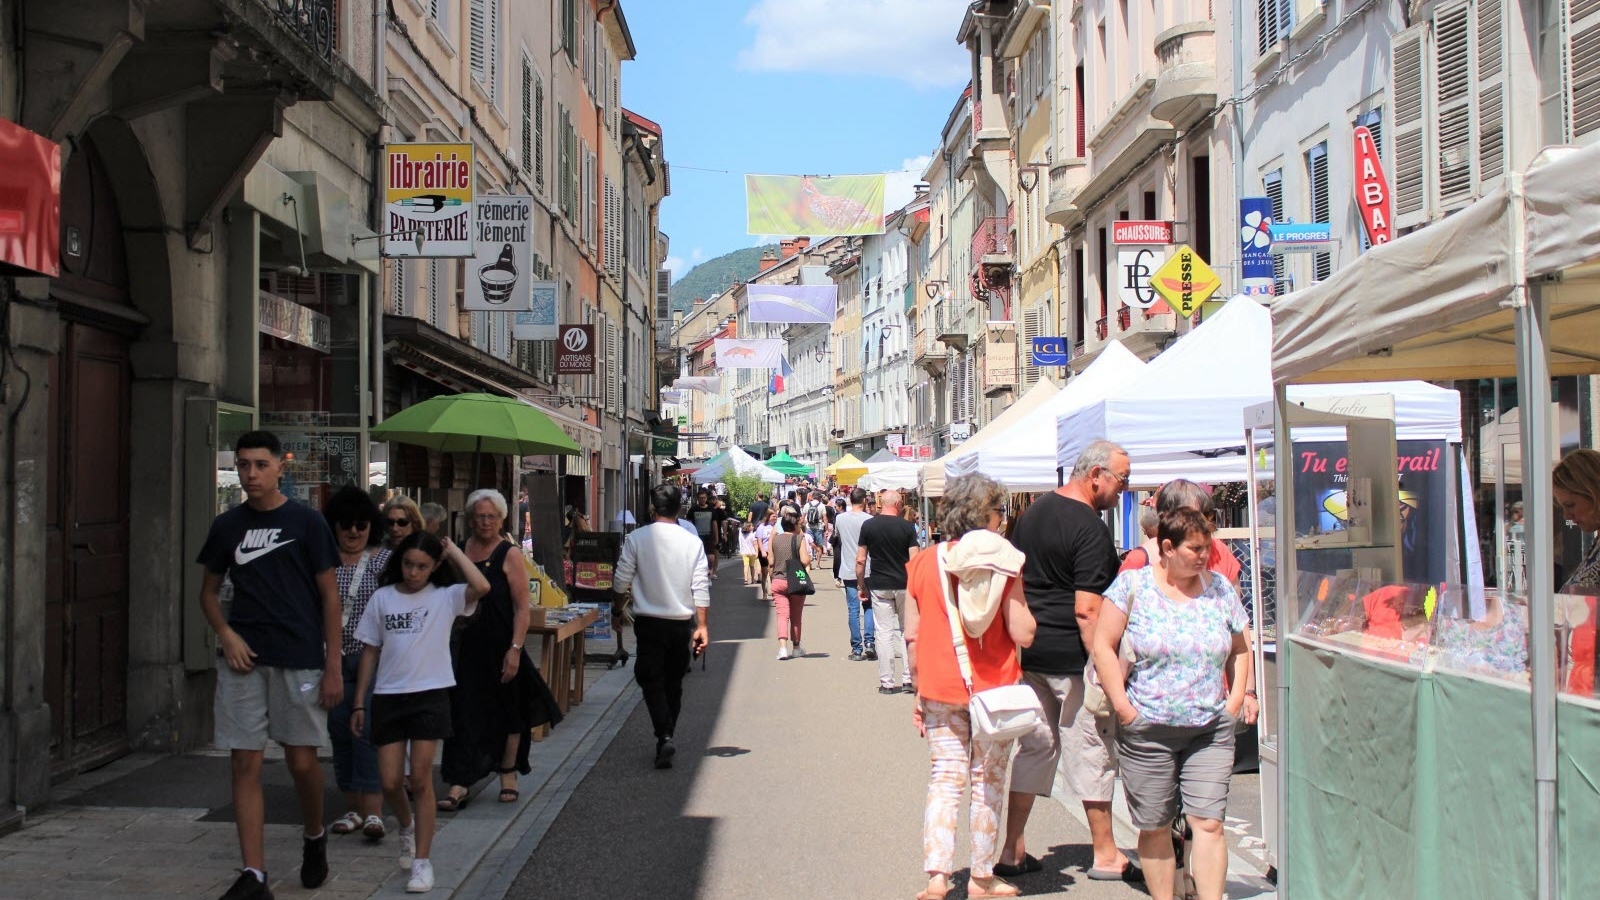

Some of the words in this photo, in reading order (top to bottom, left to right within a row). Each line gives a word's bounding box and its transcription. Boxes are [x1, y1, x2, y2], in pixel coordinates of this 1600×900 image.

[389, 153, 469, 189] librairie
[476, 200, 529, 221] rémerie
[1116, 225, 1171, 240] CHAUSSURES
[1273, 233, 1285, 241] LE
[1181, 253, 1192, 311] PRESSE
[1035, 343, 1065, 354] LCL
[560, 354, 592, 362] ARTISANS
[1301, 451, 1327, 473] Tu
[1335, 457, 1349, 472] e
[1397, 447, 1441, 472] rail
[242, 528, 282, 549] NIKE
[385, 612, 413, 622] TAKE
[385, 621, 413, 630] CARE
